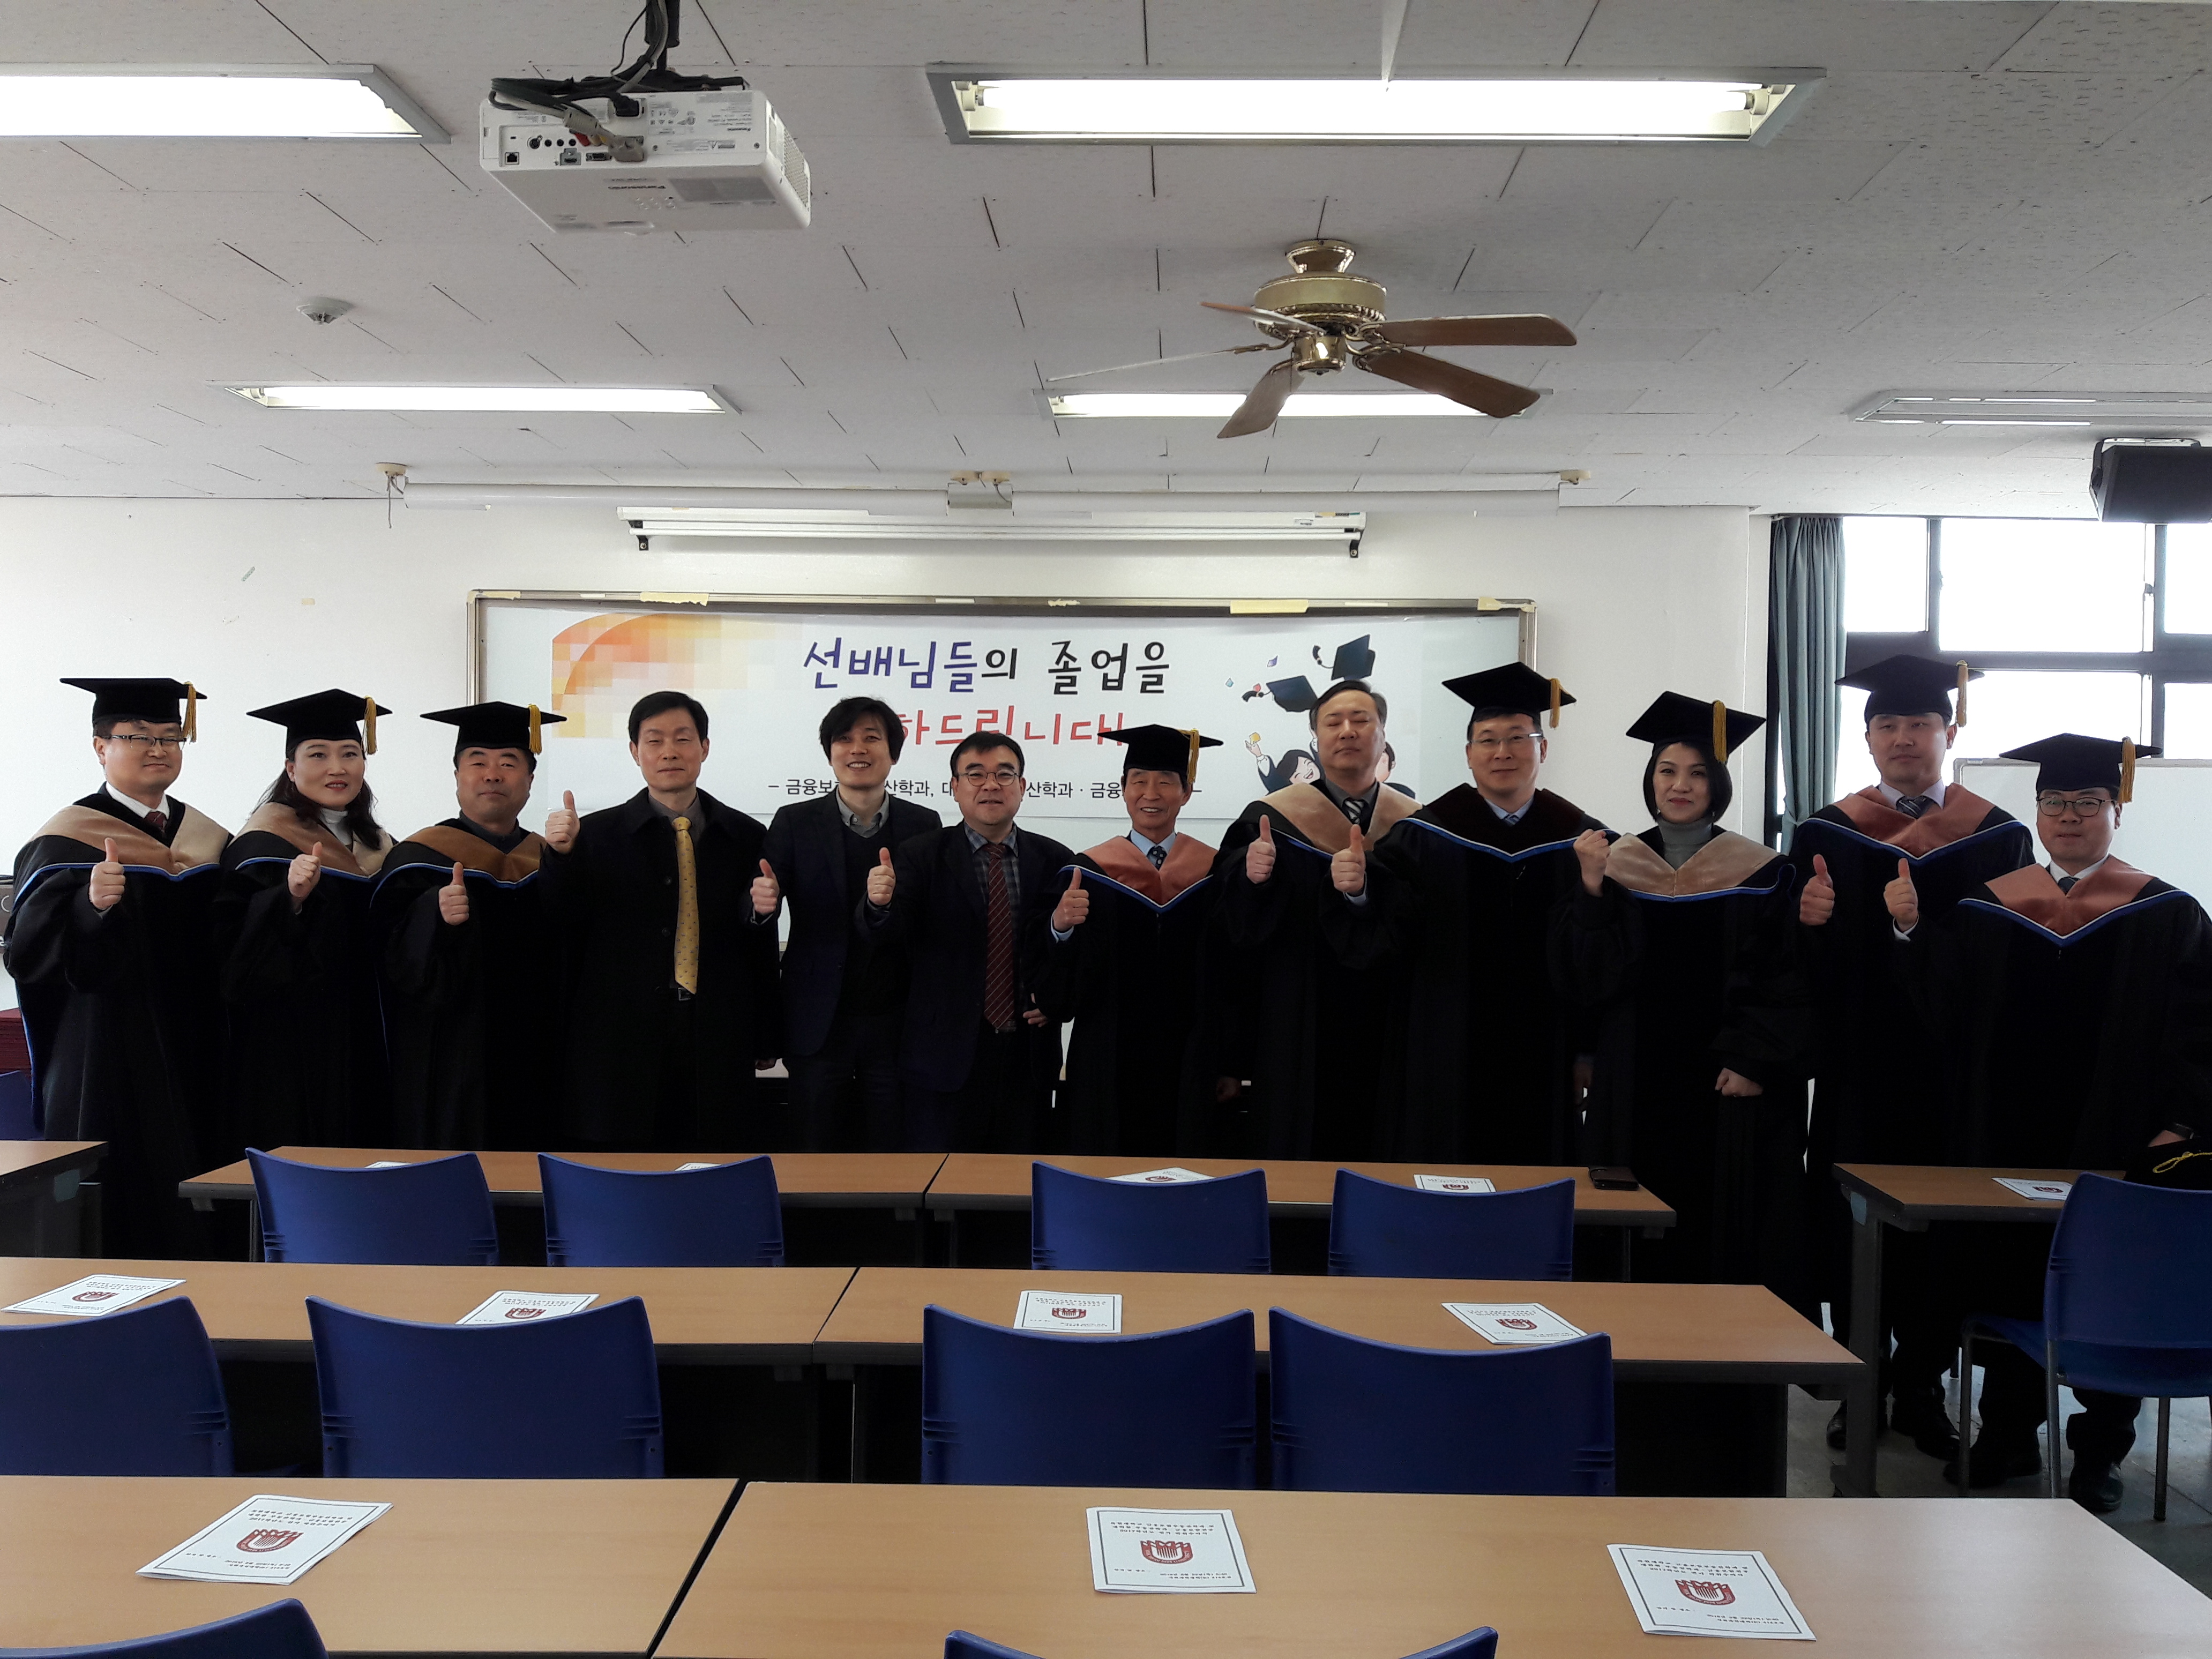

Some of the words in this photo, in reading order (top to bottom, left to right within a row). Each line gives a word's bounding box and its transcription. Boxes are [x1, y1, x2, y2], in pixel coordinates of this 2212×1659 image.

[803, 637, 1018, 693] 선배님들의
[1048, 640, 1169, 695] 졸업을
[897, 705, 1123, 746] 하드니다!
[1026, 782, 1073, 798] 산학과
[1090, 782, 1122, 798] 금융
